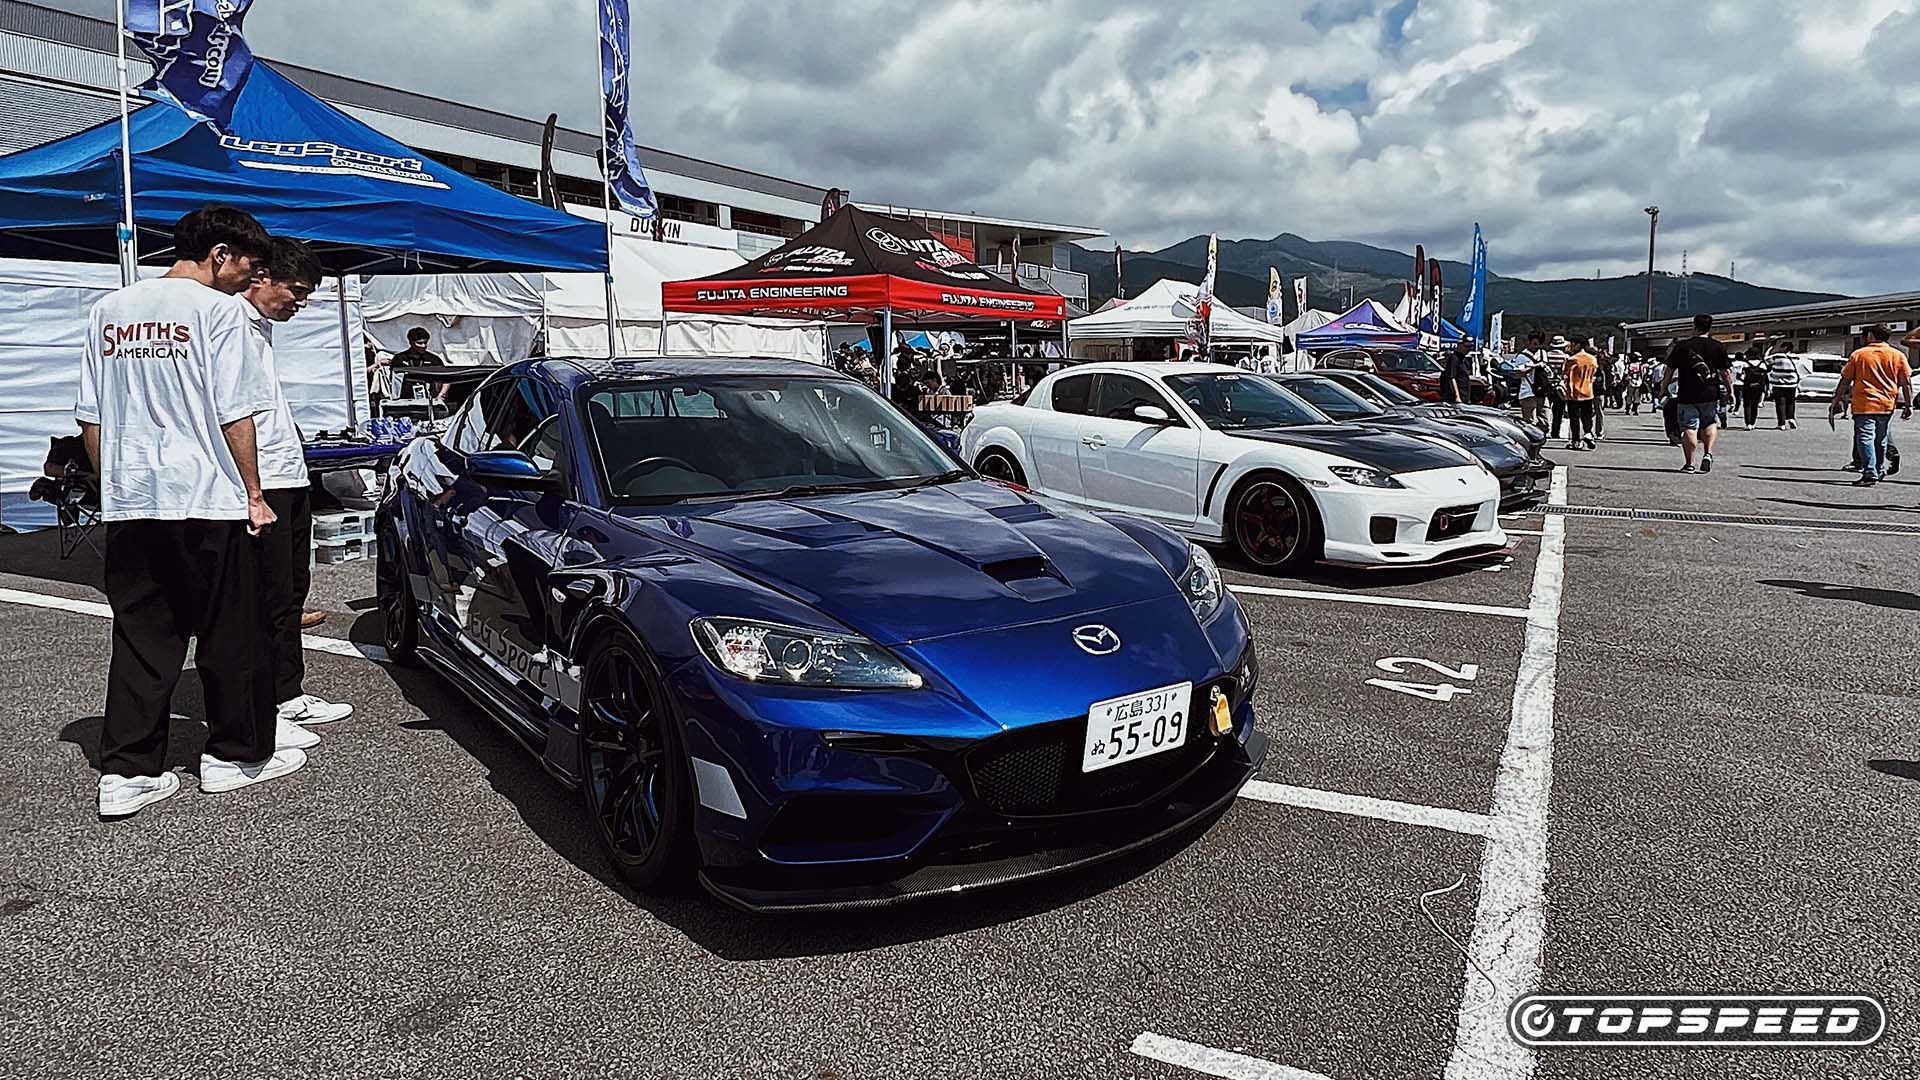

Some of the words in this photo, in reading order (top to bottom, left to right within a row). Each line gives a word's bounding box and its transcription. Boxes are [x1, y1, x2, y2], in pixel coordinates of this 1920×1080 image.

[697, 289, 746, 301] FUJITA
[750, 286, 848, 298] ENGINEERING
[941, 293, 977, 306] FUJITA
[103, 321, 190, 356] SMITH'S
[116, 347, 188, 360] AMERICAN
[1363, 656, 1480, 702] 42
[1108, 711, 1183, 760] 55-09
